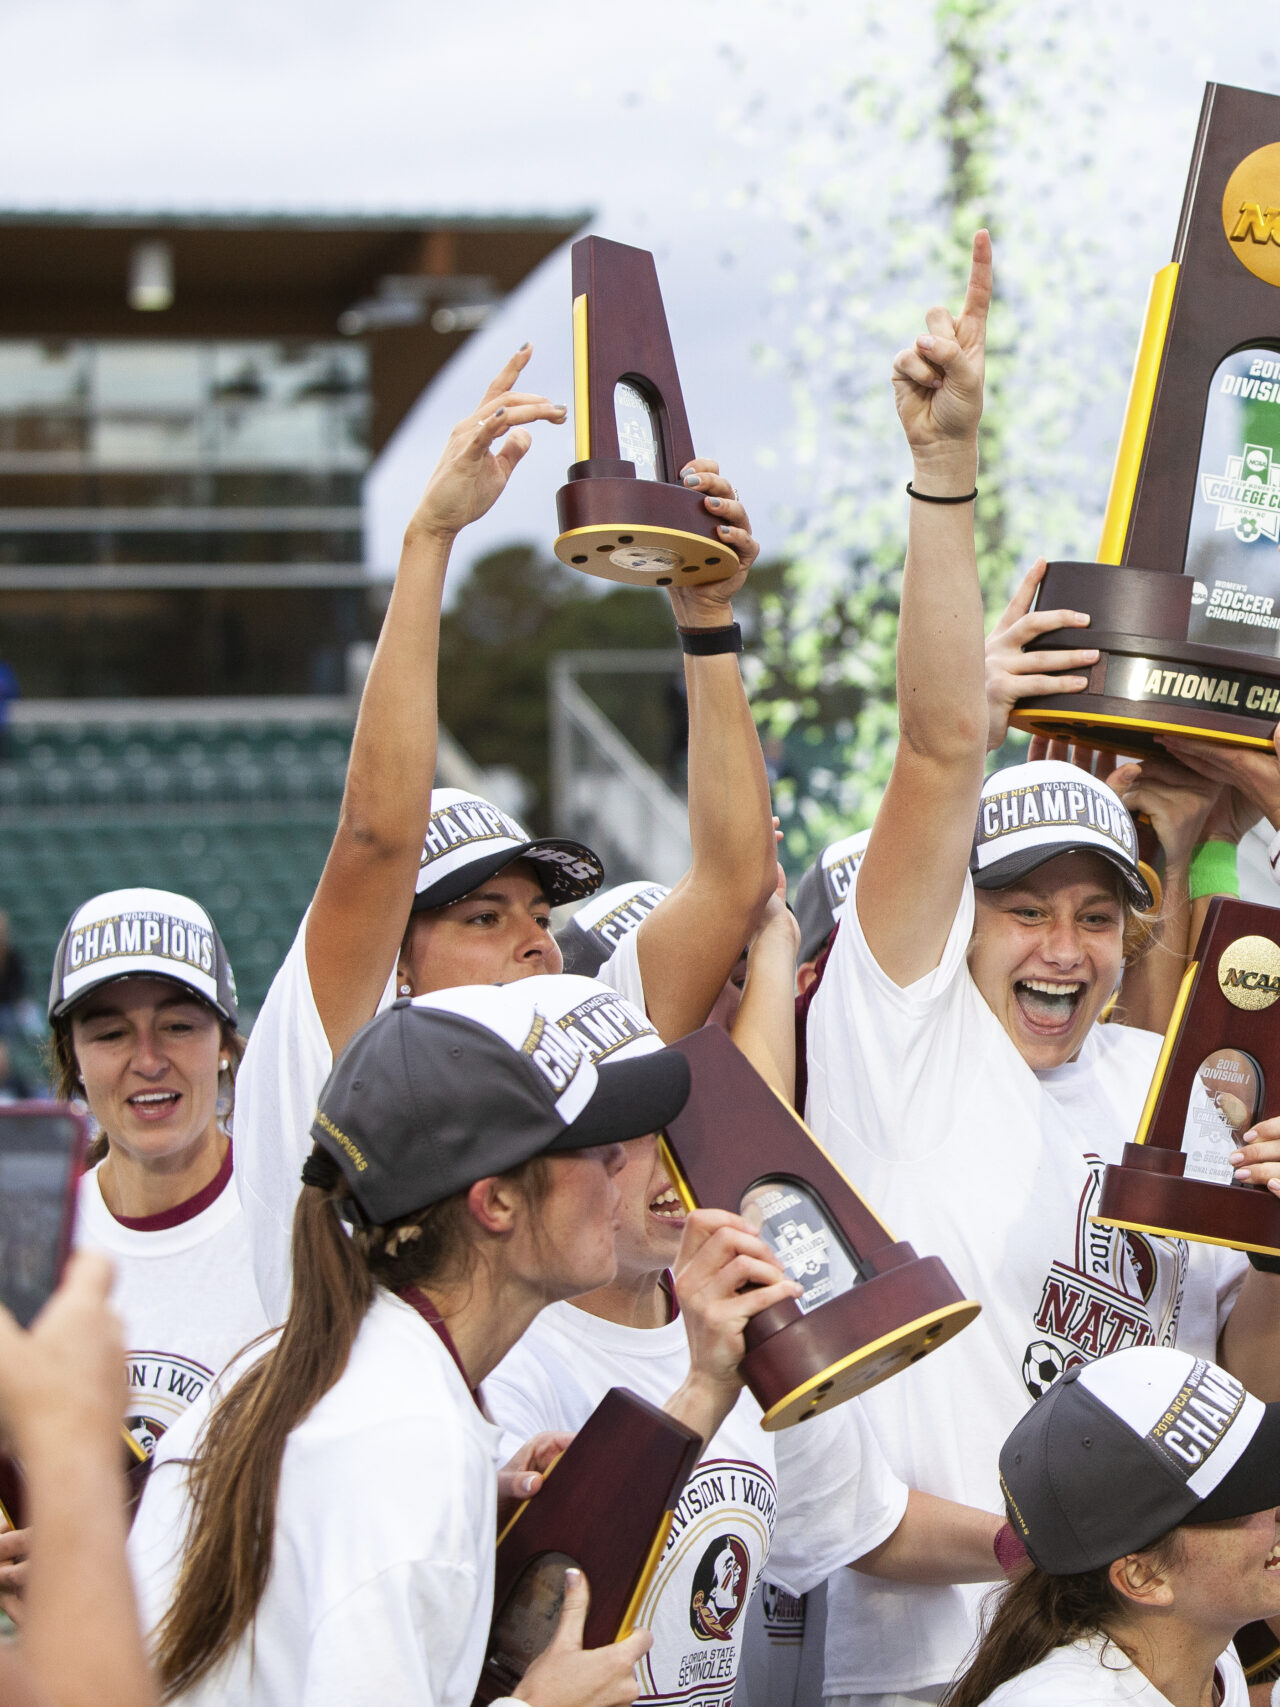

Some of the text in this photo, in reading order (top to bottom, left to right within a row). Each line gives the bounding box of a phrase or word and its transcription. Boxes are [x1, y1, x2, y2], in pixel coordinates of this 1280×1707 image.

[1210, 483, 1268, 506] COLLEGE
[1215, 580, 1248, 592] WOMEN'S
[1209, 588, 1274, 615] SOCCER
[1141, 667, 1240, 706] ATIONAL
[1011, 785, 1040, 798] NCAA
[1043, 782, 1093, 797] WOMEN'S
[983, 790, 1133, 852] CHAMPIONS
[122, 910, 170, 922] WOMEN'S
[70, 919, 213, 973] CHAMPIONS
[1203, 1067, 1243, 1084] DIVISION
[1216, 1058, 1240, 1071] 2018
[1203, 1153, 1231, 1167] SOCCE
[153, 1367, 163, 1388] I
[1170, 1386, 1194, 1415] NCAA
[1163, 1367, 1244, 1465] CHAMP
[730, 1475, 736, 1502] I
[681, 1648, 708, 1667] FLORIDA
